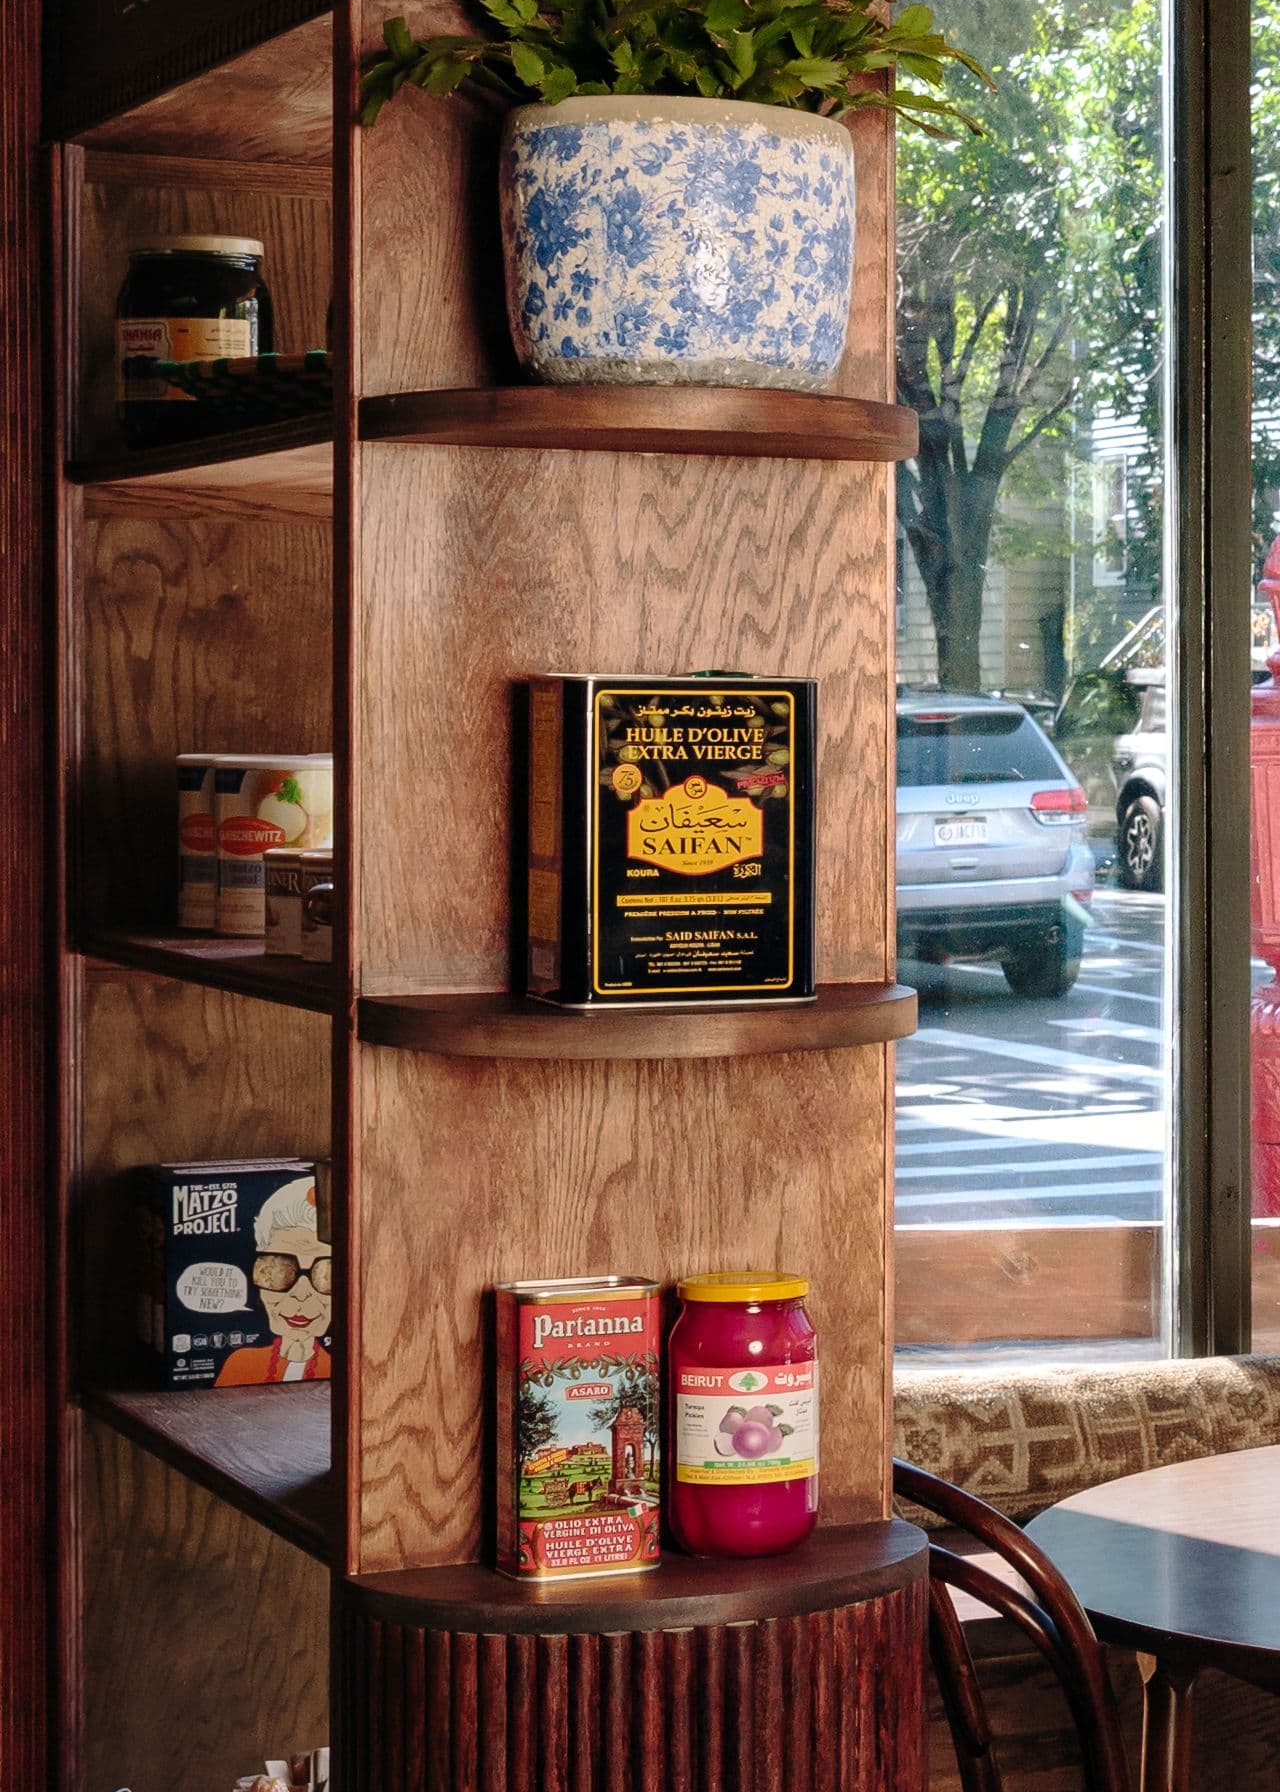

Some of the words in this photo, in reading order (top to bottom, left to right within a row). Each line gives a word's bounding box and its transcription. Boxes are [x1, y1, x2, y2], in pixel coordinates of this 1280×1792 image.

[626, 728, 683, 743] HUILE
[688, 727, 765, 742] D'OLIVE
[628, 745, 688, 760] EXTRA
[693, 745, 762, 759] VIERGE
[945, 793, 980, 805] Jeep
[642, 836, 743, 856] SAIFAN
[626, 868, 660, 878] KOURA
[665, 931, 693, 941] SAID
[694, 930, 735, 941] SAIFAN
[173, 1185, 238, 1225] MATZO
[173, 1207, 237, 1235] PROJECT
[200, 1266, 223, 1277] WOULD
[225, 1267, 233, 1277] IT
[211, 1277, 226, 1287] YOU
[227, 1278, 238, 1288] TO
[183, 1286, 198, 1296] TRY
[533, 1314, 643, 1348] Partanna
[681, 1374, 724, 1387] BEIRUT
[571, 1386, 609, 1398] ASARO
[556, 1520, 582, 1530] OLIO
[585, 1516, 623, 1527] EXTRA
[543, 1529, 586, 1539] VERGINE
[590, 1526, 601, 1535] DI
[604, 1523, 635, 1534] OLIVA
[546, 1541, 582, 1550] HUILE
[546, 1548, 589, 1559] VIERGE
[593, 1544, 633, 1554] EXTRA
